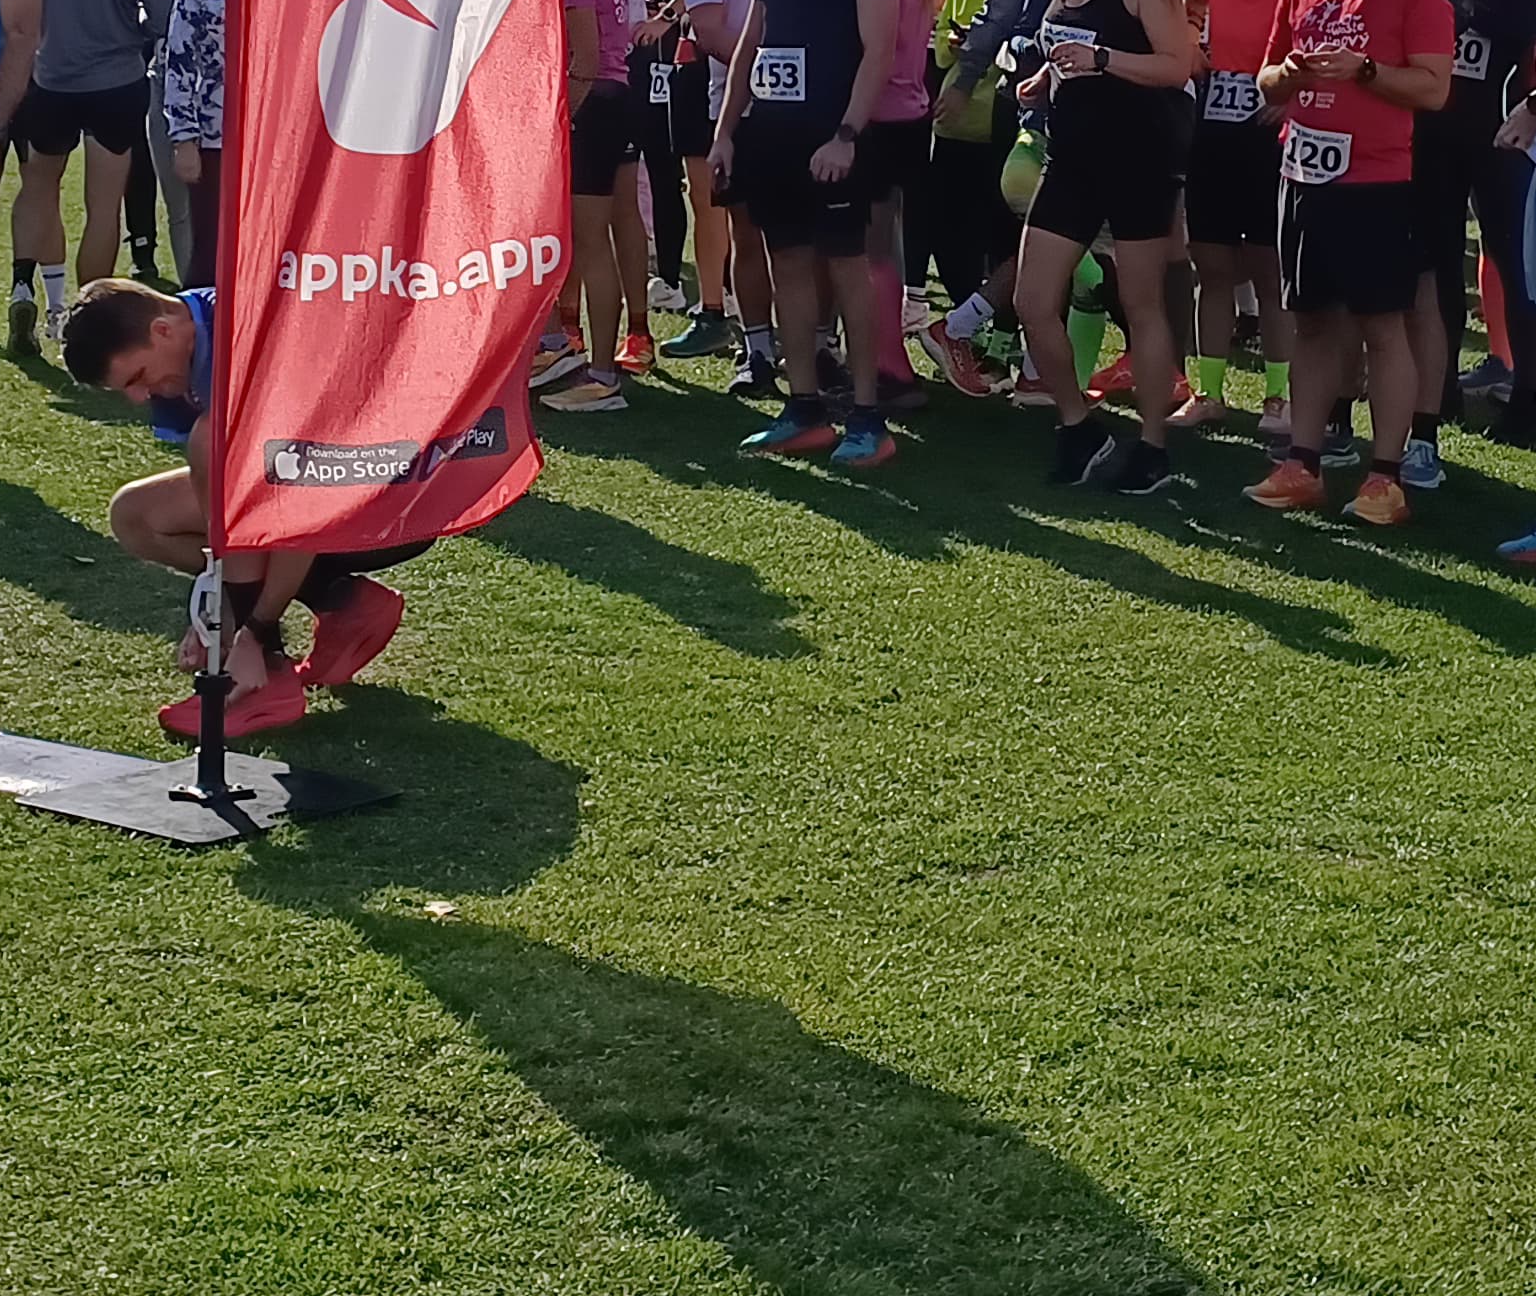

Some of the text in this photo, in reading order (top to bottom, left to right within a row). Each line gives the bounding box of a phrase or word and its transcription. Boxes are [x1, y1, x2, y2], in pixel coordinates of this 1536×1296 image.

[755, 62, 799, 89] 153
[1210, 84, 1260, 112] 213
[1286, 136, 1342, 172] 120
[278, 234, 562, 301] appka.app
[466, 428, 496, 448] Play
[303, 459, 410, 482] App Store
